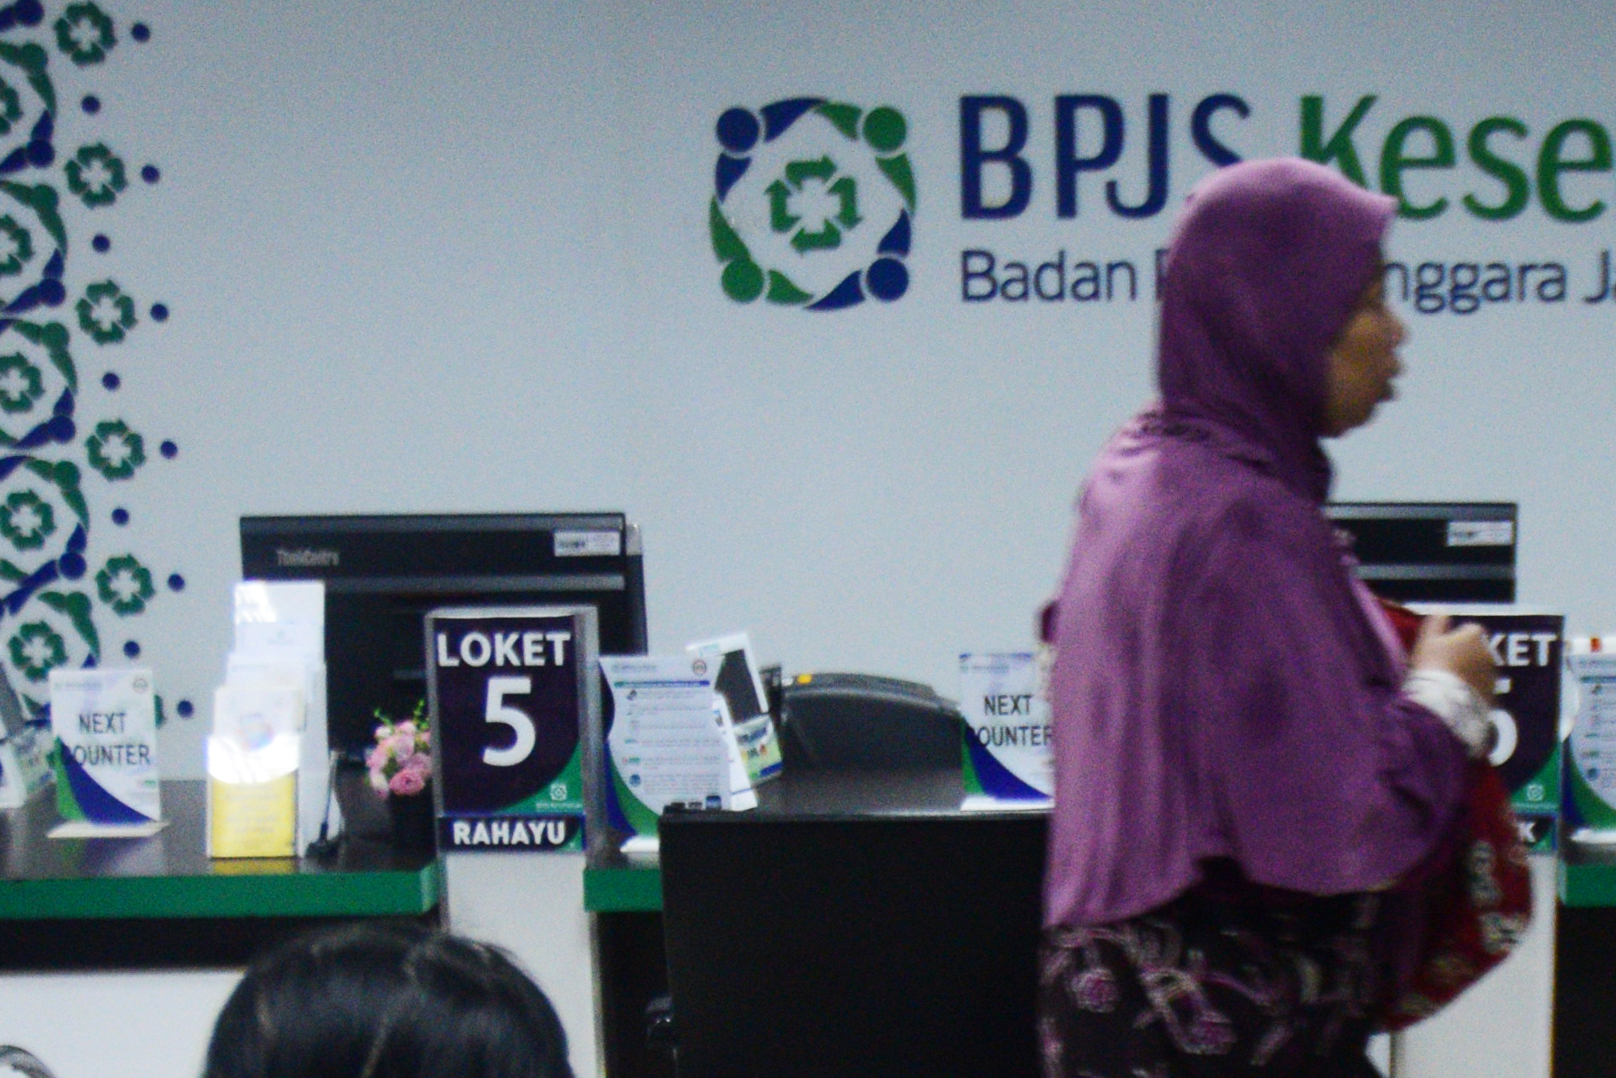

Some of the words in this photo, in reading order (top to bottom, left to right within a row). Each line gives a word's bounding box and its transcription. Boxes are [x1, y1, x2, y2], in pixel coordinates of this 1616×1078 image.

[960, 94, 1251, 219] BPJS
[961, 250, 1136, 302] Badan
[437, 631, 571, 667] LOKET
[1484, 632, 1557, 667] KET
[983, 694, 1033, 715] NEXT
[79, 712, 125, 733] NEXT
[482, 675, 536, 767] 5
[967, 725, 1052, 747] OUNTER
[64, 743, 151, 766] OUNTER
[453, 819, 566, 845] RAHAYU
